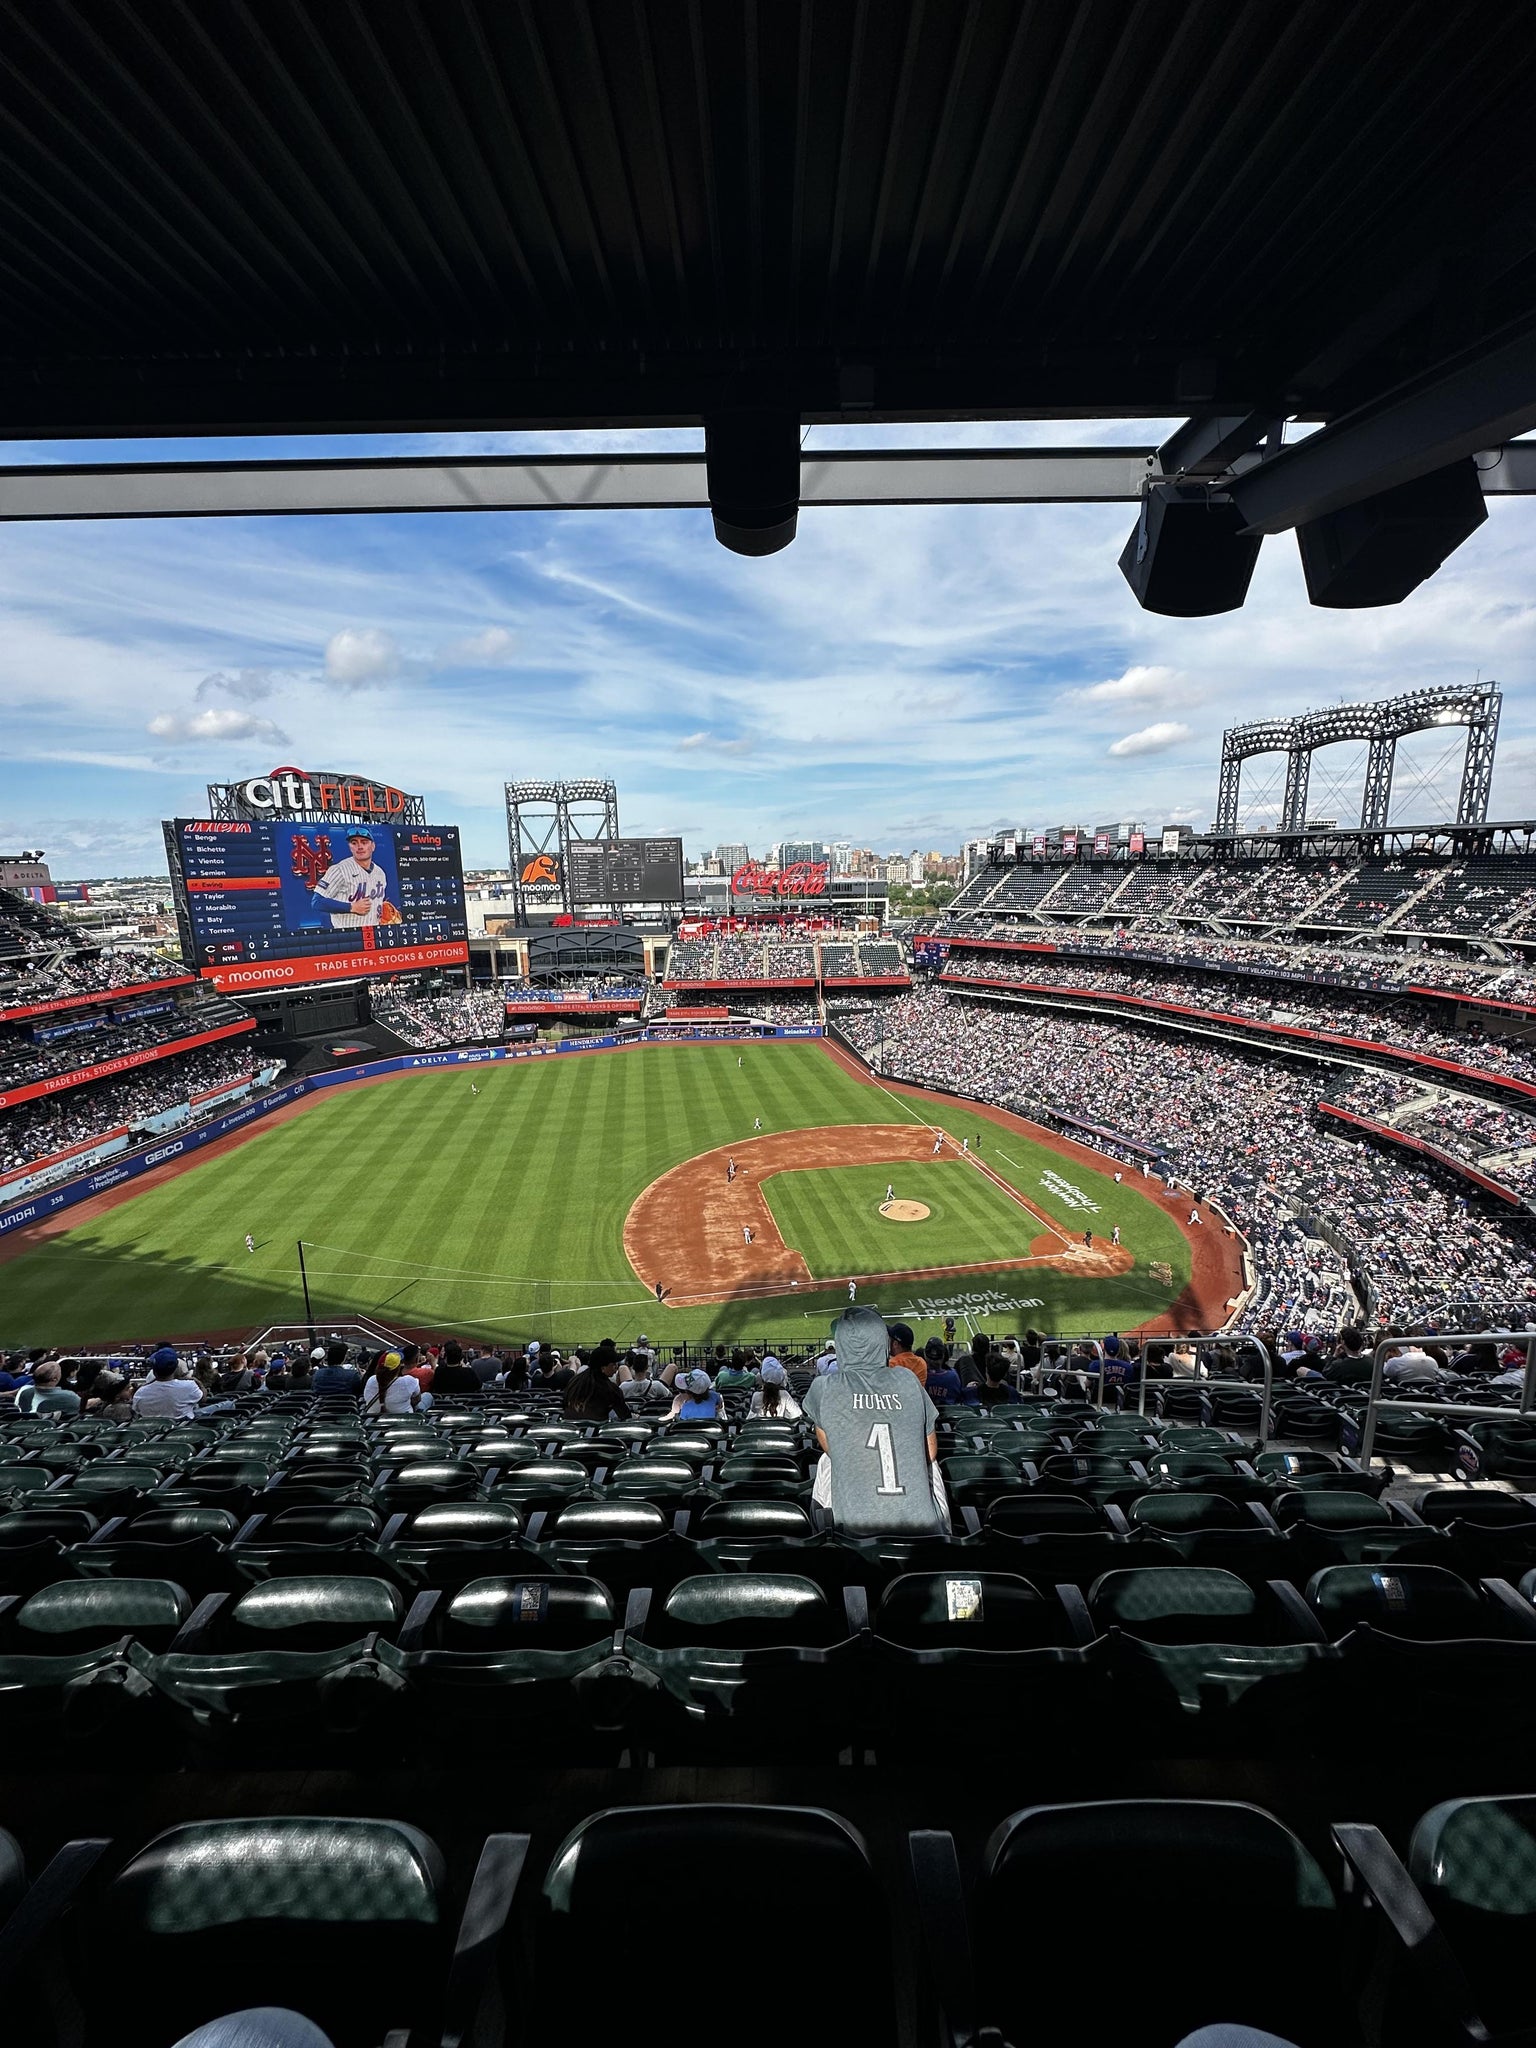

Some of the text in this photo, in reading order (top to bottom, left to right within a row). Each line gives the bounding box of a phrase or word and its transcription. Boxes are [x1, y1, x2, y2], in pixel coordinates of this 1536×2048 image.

[320, 784, 405, 812] FIELD
[412, 834, 441, 846] Ewing
[429, 924, 441, 933] 1-1
[229, 967, 294, 983] moomoo
[314, 960, 348, 971] TRADE
[352, 958, 376, 968] ETFs,
[379, 952, 415, 964] STOCKS
[426, 948, 464, 958] OPTIONS
[1250, 967, 1279, 976] VELOCITY:
[31, 1003, 49, 1013] TRADE
[65, 997, 83, 1007] STOCKS
[90, 992, 112, 1001] OPTIONS
[44, 1078, 72, 1091] TRADE
[73, 1071, 93, 1082] ETFs,
[94, 1062, 122, 1076] STOCKS
[130, 1050, 158, 1064] OPTIONS
[1466, 1069, 1494, 1081] moomoo
[268, 1093, 287, 1106] Guardian
[228, 1113, 245, 1124] invesco
[145, 1141, 183, 1165] GEICO
[95, 1171, 128, 1189] Presbyterian
[50, 1195, 64, 1205] 358
[917, 1289, 1008, 1308] NewYork-
[925, 1296, 1044, 1317] Presbyterian
[928, 1386, 948, 1397] AVER
[853, 1393, 902, 1410] HURTS
[865, 1422, 906, 1496] 1
